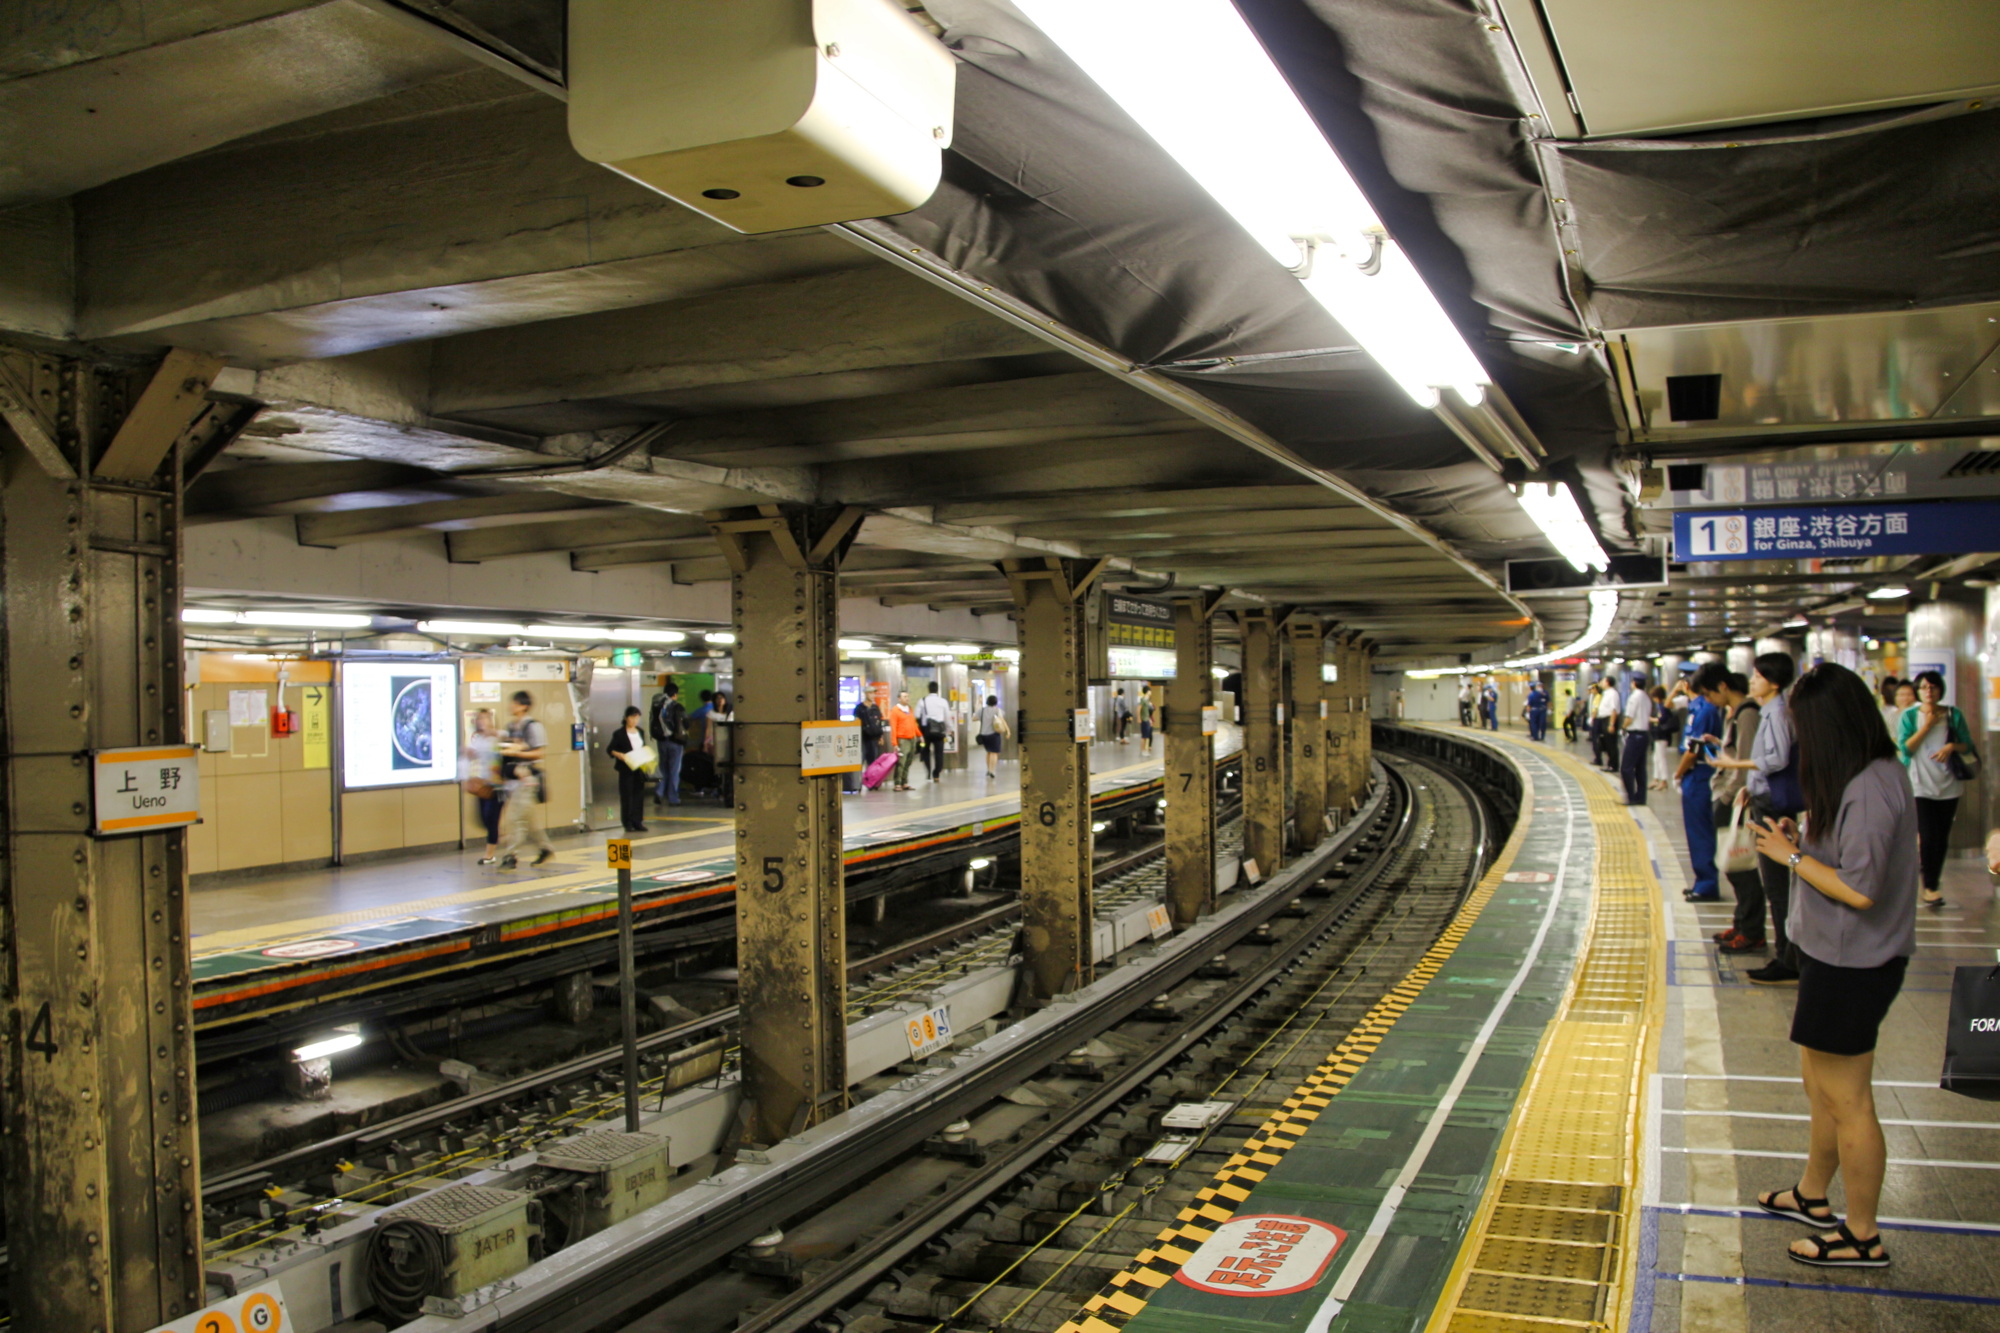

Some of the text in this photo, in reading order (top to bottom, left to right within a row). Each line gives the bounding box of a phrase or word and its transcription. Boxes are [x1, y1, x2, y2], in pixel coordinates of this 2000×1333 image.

[1700, 519, 1716, 552] 1
[1753, 512, 1908, 539] 銀座・渋谷方面
[1754, 537, 1872, 551] for Ginza, Shibuya
[1303, 744, 1313, 758] 9
[1255, 757, 1266, 772] 8
[117, 766, 182, 794] 上野
[1179, 773, 1193, 792] 7
[132, 795, 167, 810] Ueno
[1039, 801, 1056, 827] 6
[762, 856, 784, 893] 5
[26, 1001, 58, 1064] 4
[1205, 1219, 1311, 1289] 足元に注意
[253, 1307, 268, 1326] G
